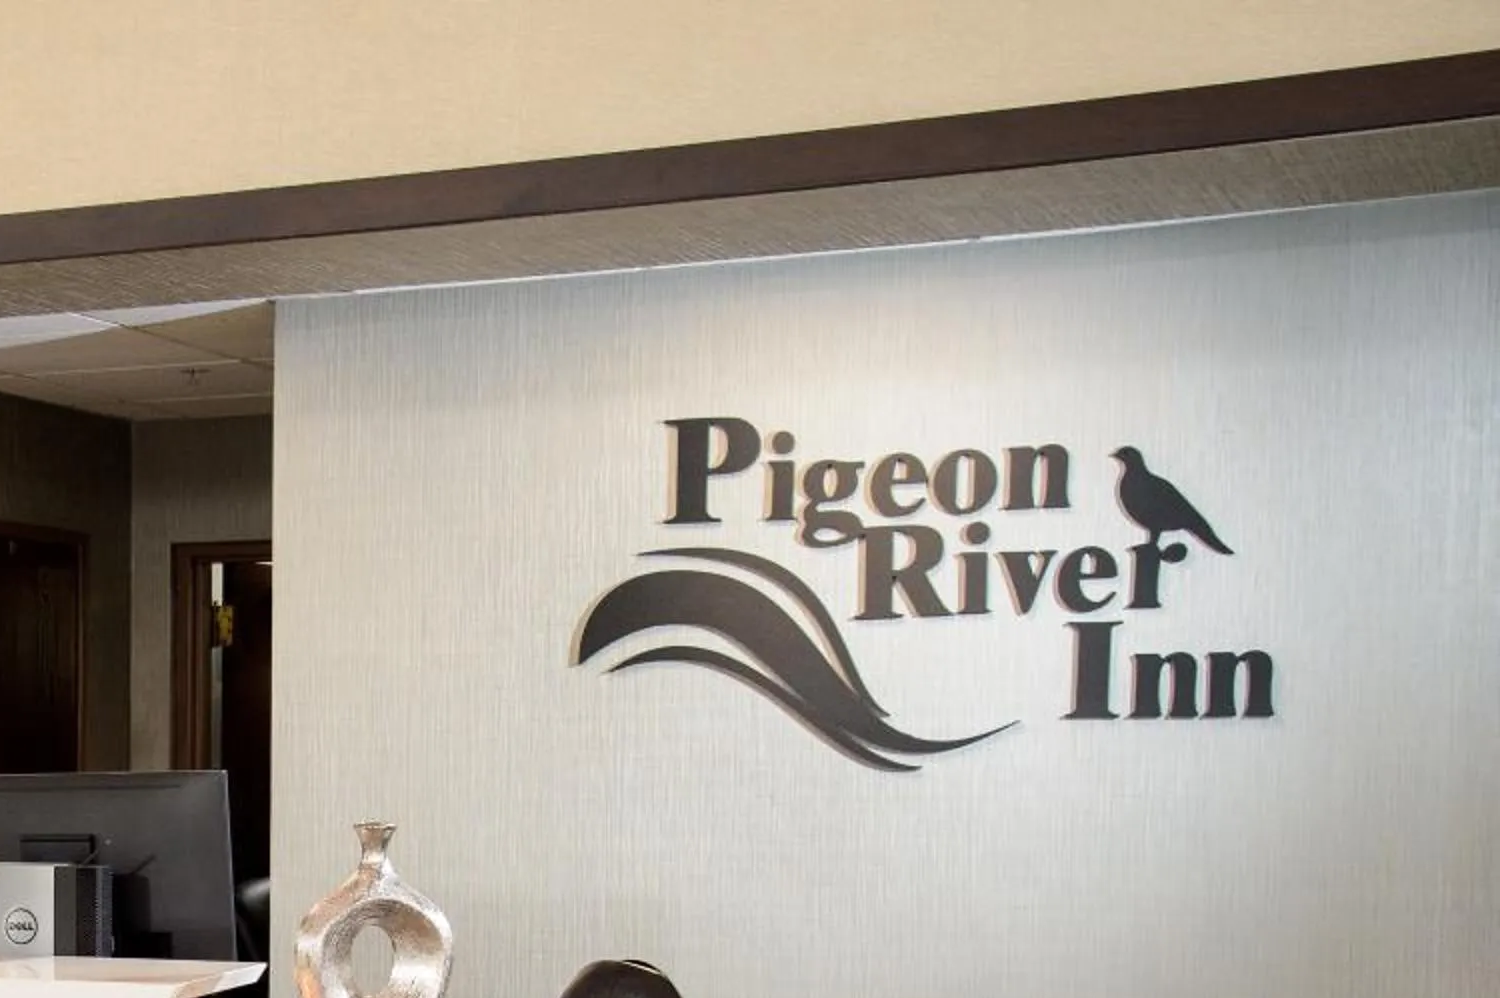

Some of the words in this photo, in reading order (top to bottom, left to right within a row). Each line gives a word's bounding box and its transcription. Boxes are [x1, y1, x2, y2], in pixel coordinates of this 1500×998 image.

[657, 416, 1071, 548] Pigeon
[850, 520, 1188, 621] River
[1061, 619, 1275, 721] Inn
[8, 920, 35, 931] DELL
